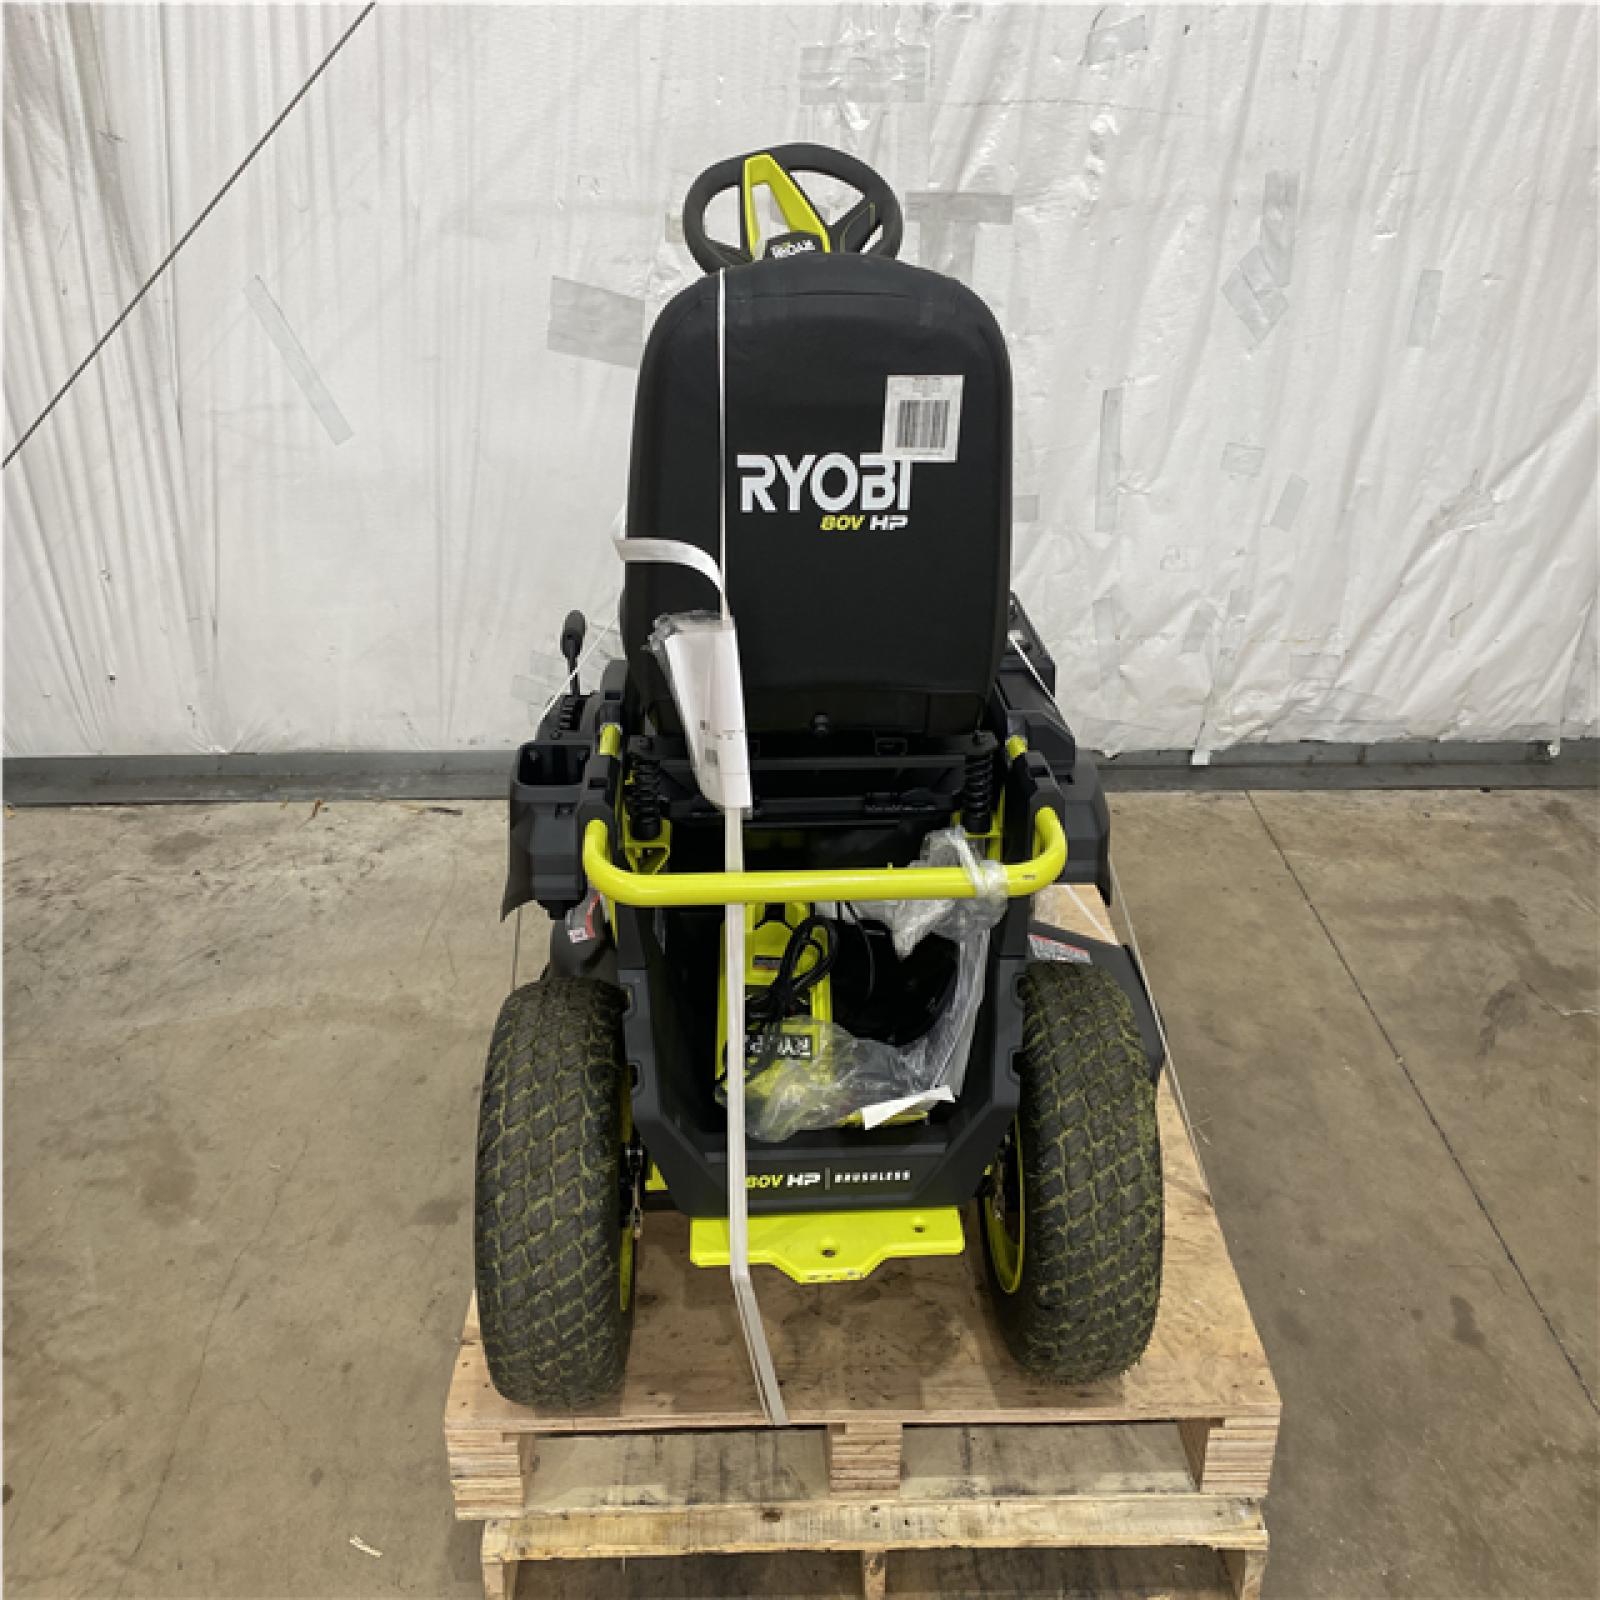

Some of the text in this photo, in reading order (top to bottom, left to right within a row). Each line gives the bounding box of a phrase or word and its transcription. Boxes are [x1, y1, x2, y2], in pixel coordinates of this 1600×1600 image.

[736, 452, 911, 512] RYOBI
[820, 515, 908, 531] 80V HP
[787, 1172, 821, 1187] HP
